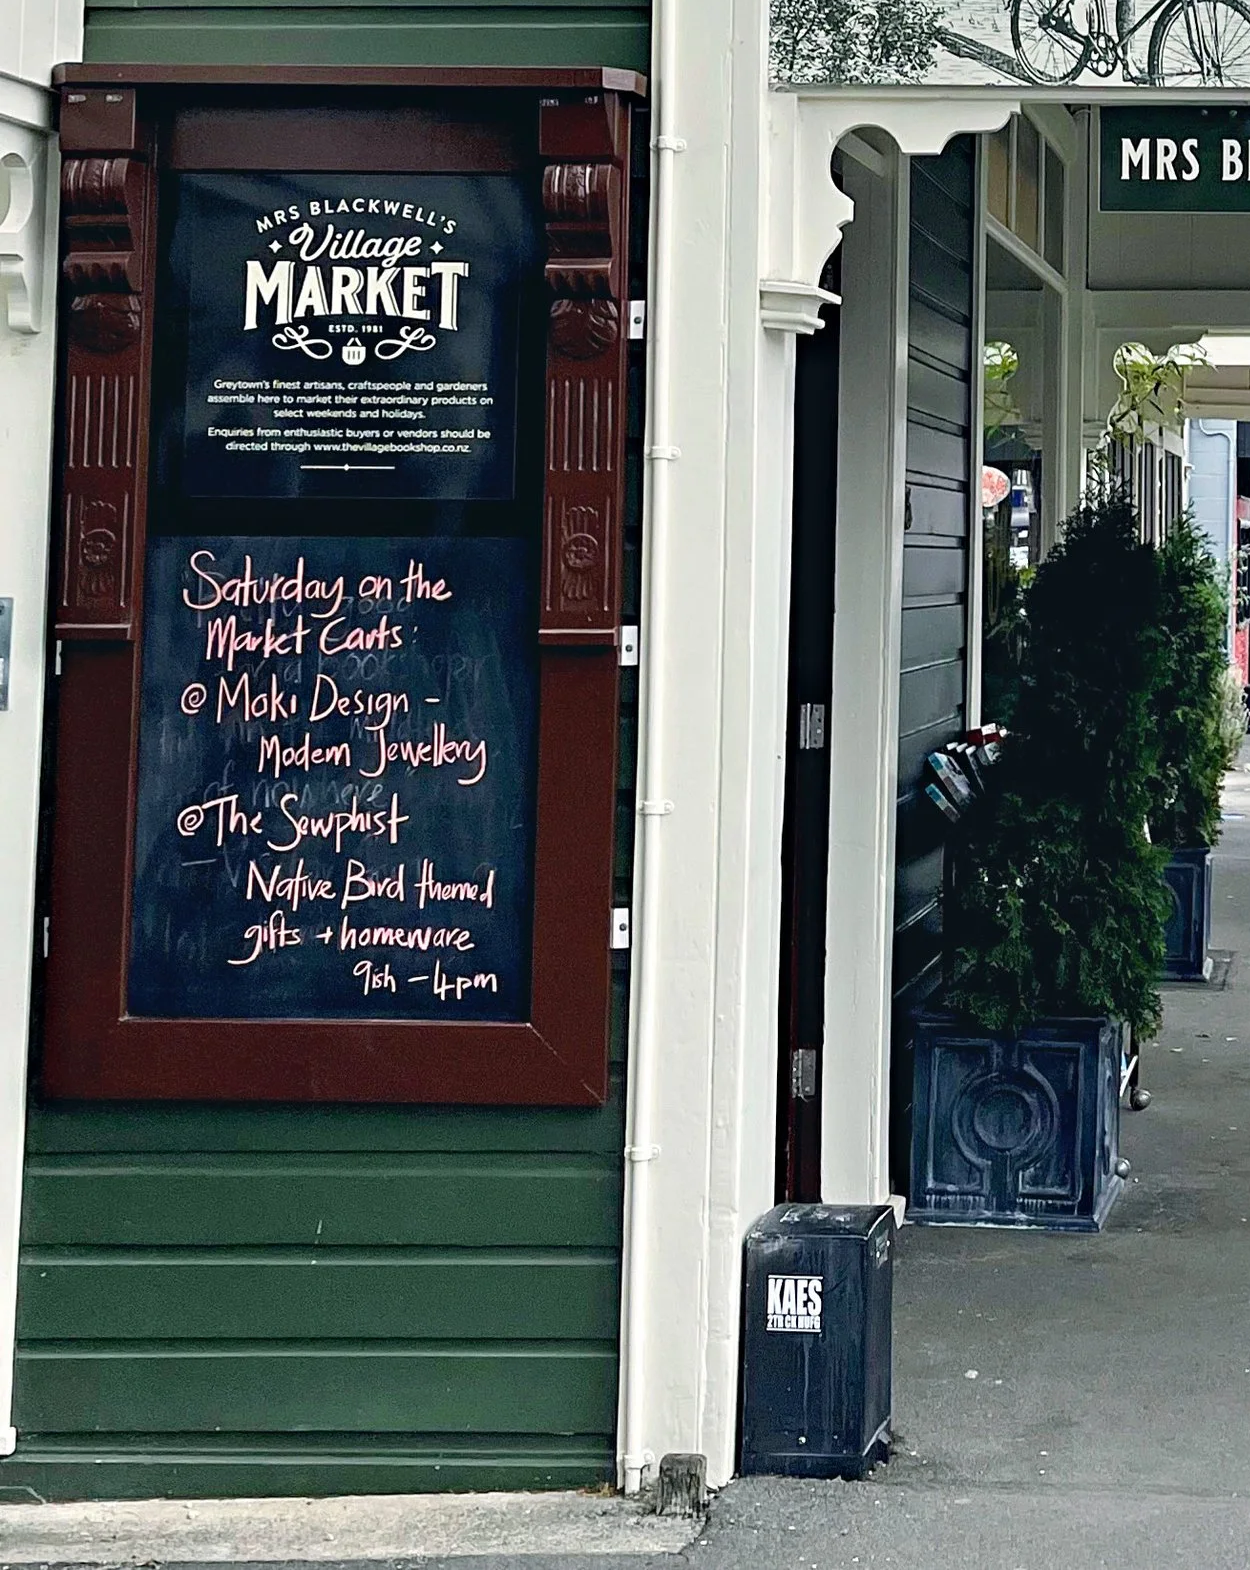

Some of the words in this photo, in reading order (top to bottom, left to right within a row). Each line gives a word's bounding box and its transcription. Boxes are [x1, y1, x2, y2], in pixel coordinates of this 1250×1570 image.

[1120, 138, 1199, 181] MRS
[256, 205, 301, 234] MRS
[309, 197, 457, 234] BLACKWELL'S
[288, 222, 422, 268] Village
[243, 260, 469, 331] MARKET
[328, 324, 359, 334] ESTD.
[362, 324, 383, 334] 1981
[207, 393, 255, 404] assemble
[257, 393, 281, 404] here
[283, 394, 294, 404] to
[296, 394, 332, 405] market
[334, 394, 358, 405] their
[360, 395, 429, 407] extraordinary
[431, 396, 477, 407] products
[479, 396, 494, 406] on
[213, 379, 270, 391] Greytown's
[272, 379, 301, 390] finest
[303, 380, 346, 391] artisans,
[347, 380, 412, 392] craftspeople
[414, 381, 434, 391] and
[436, 382, 488, 393] gardeners
[207, 426, 255, 438] Enquiries
[257, 427, 281, 437] from
[283, 428, 343, 438] enthusiastic
[346, 428, 381, 440] buyers
[383, 429, 395, 439] or
[397, 429, 438, 439] vendors
[440, 429, 475, 440] should
[477, 430, 491, 440] be
[273, 408, 304, 419] select
[306, 409, 357, 419] weekends
[359, 409, 379, 420] and
[381, 409, 427, 421] holidays.
[225, 440, 268, 451] directed
[271, 441, 312, 453] through
[183, 549, 345, 618] Saturday
[358, 575, 392, 602] on
[400, 558, 452, 601] the
[205, 614, 311, 671] Market
[216, 677, 298, 724] Moki
[309, 672, 411, 732] Design
[358, 723, 488, 787] Jewellery
[245, 860, 336, 911] Native
[341, 859, 403, 909] Bird
[414, 857, 494, 910] themed
[227, 910, 301, 965] gifts
[340, 916, 475, 952] homeware
[353, 961, 396, 996] 9ish
[768, 1278, 822, 1316] KAES
